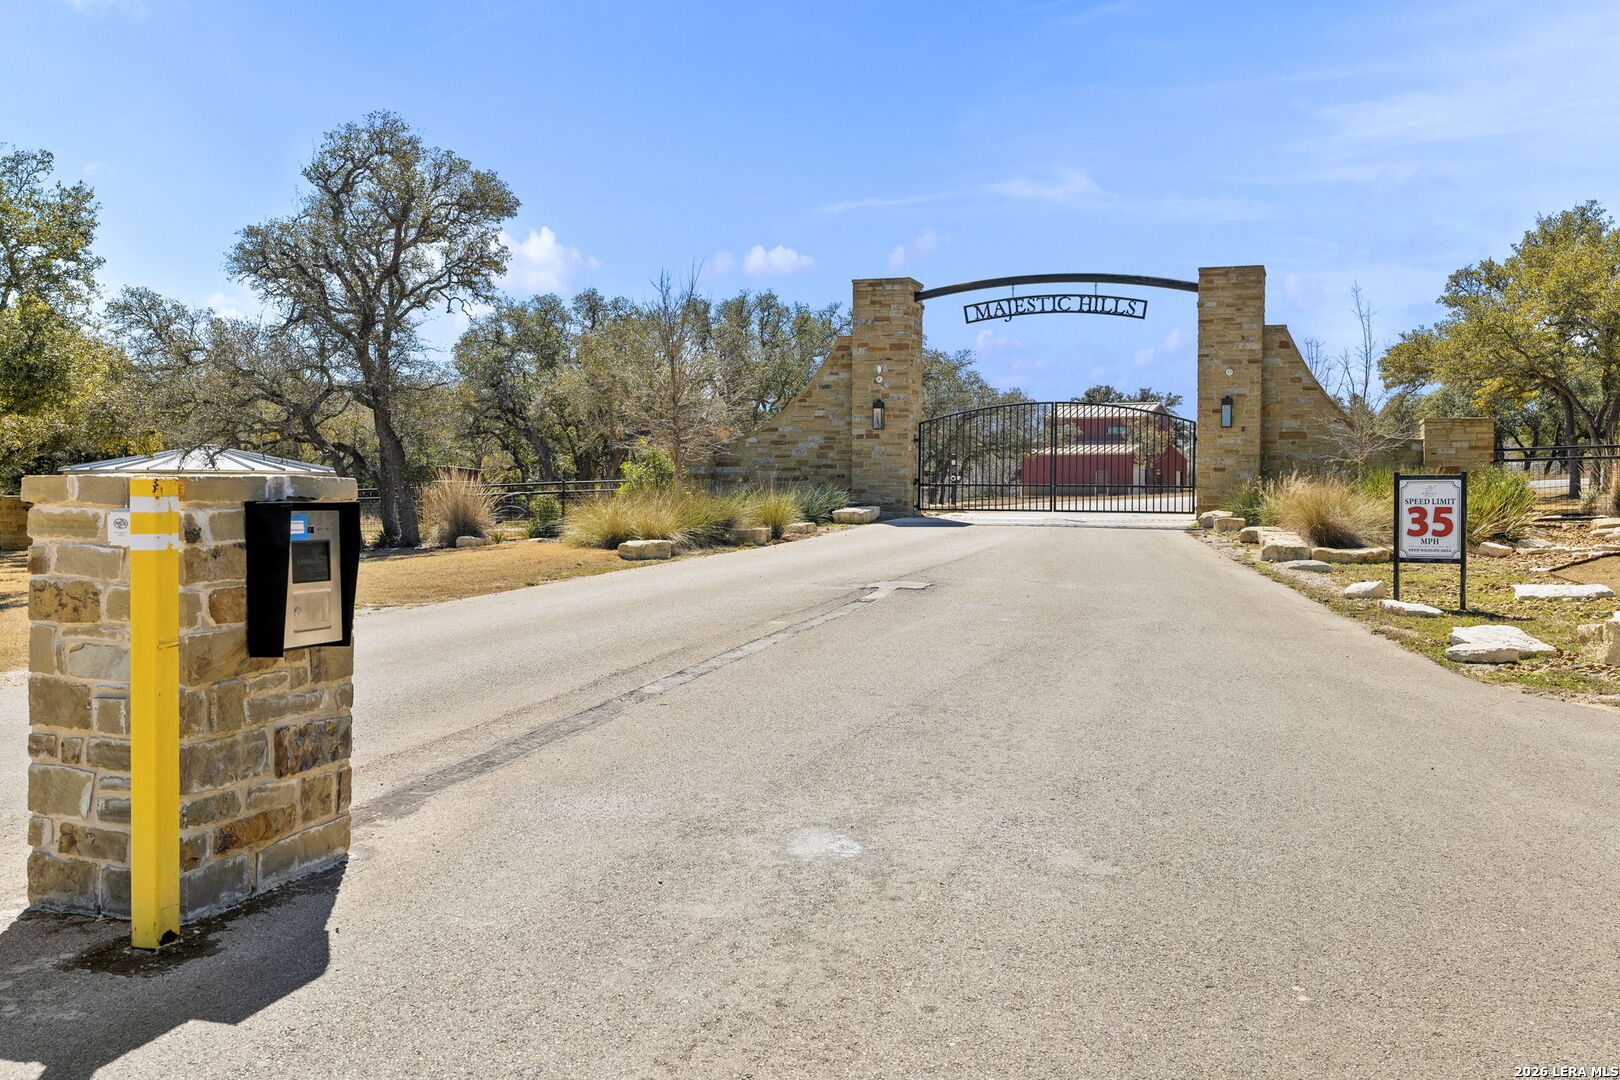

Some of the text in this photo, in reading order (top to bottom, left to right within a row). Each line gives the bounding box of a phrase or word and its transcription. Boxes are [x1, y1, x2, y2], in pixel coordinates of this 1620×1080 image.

[974, 296, 1137, 323] MAJESTIC HILLS
[1406, 506, 1454, 537] 35
